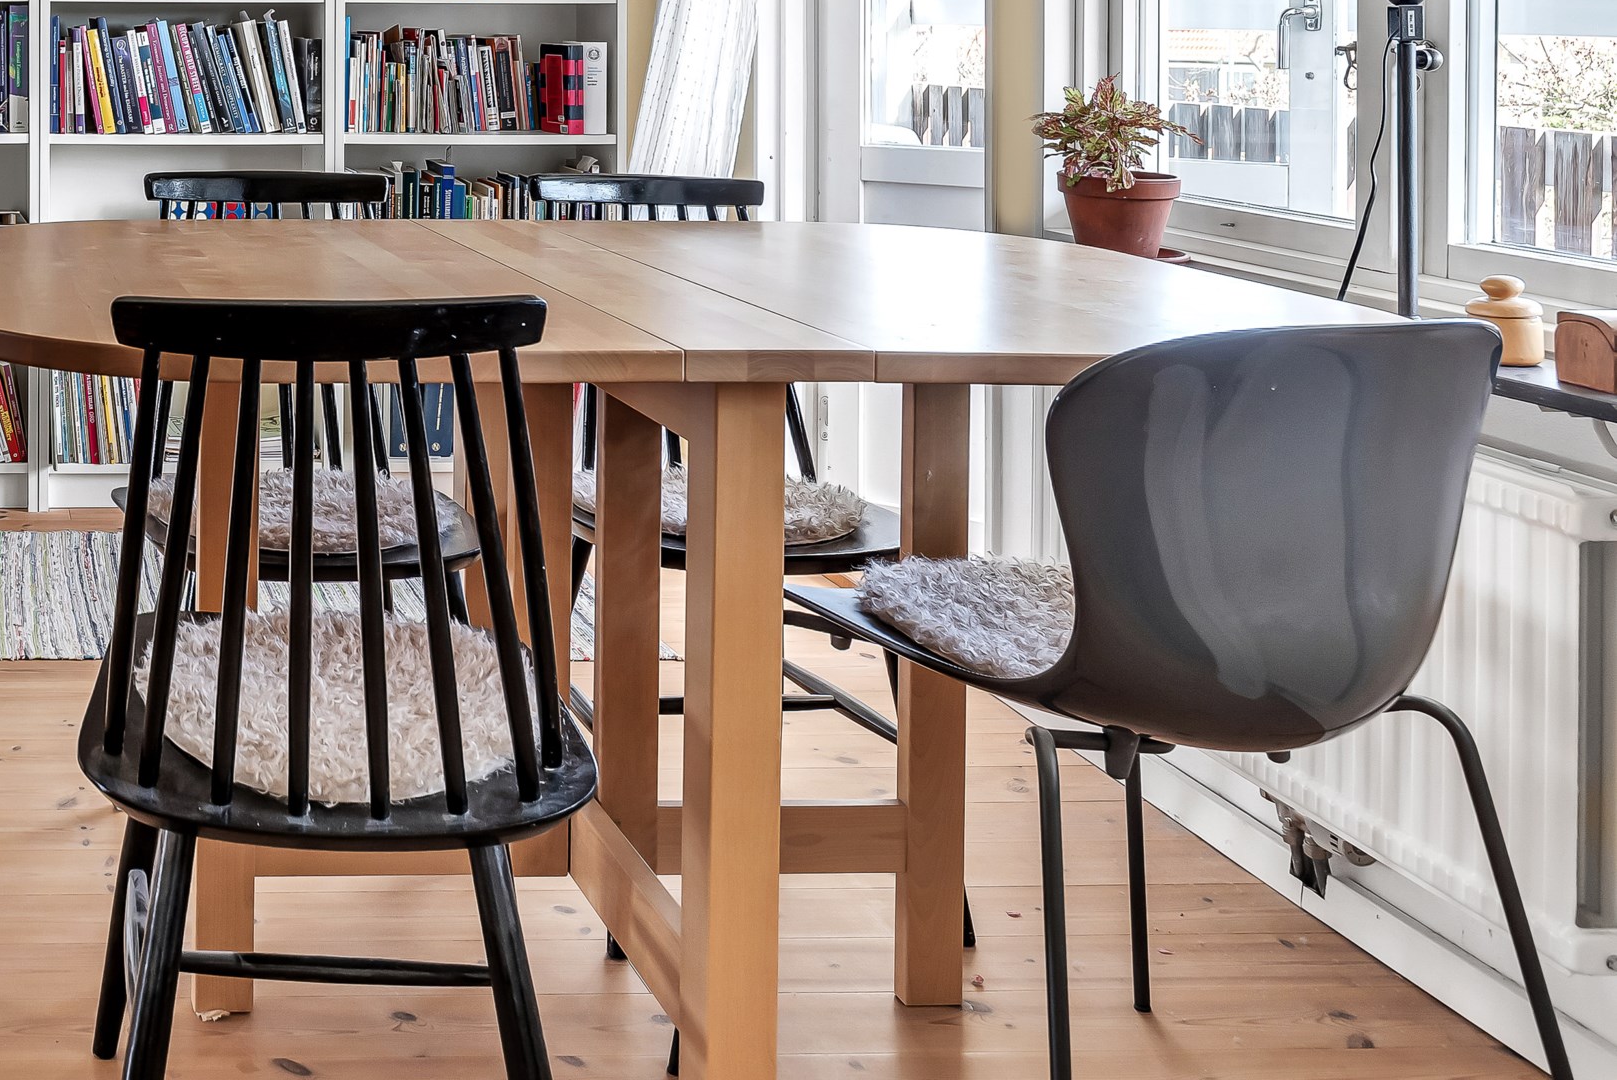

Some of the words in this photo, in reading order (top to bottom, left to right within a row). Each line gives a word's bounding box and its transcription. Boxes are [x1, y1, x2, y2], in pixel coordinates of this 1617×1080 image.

[178, 25, 189, 48] OCCUPY
[185, 50, 195, 70] WORLD
[190, 71, 199, 91] STREET
[162, 94, 170, 120] Democracy
